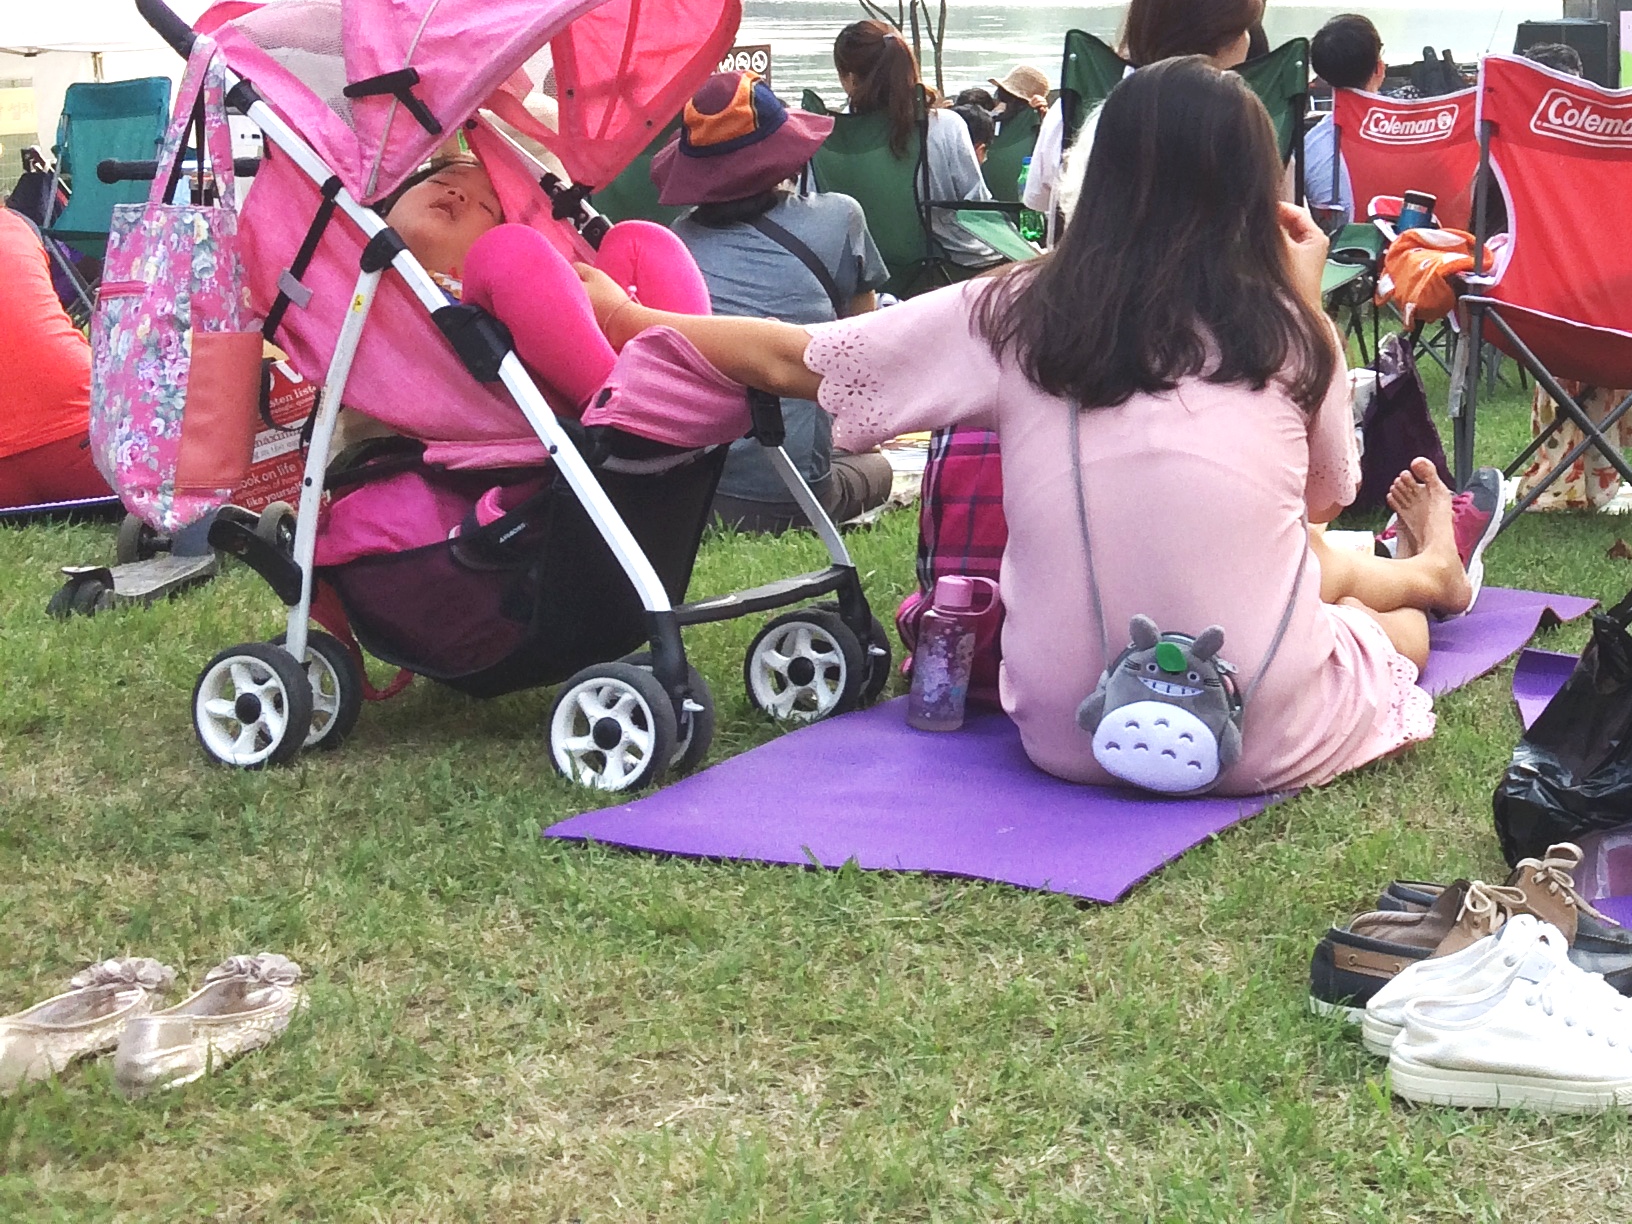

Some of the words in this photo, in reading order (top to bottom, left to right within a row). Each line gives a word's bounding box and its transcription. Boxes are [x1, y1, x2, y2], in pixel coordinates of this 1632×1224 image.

[1369, 112, 1436, 135] Coleman
[269, 392, 293, 407] sten
[241, 472, 261, 489] ook
[262, 470, 277, 482] on
[278, 462, 297, 476] life
[246, 496, 264, 508] like
[265, 480, 303, 503] yourself
